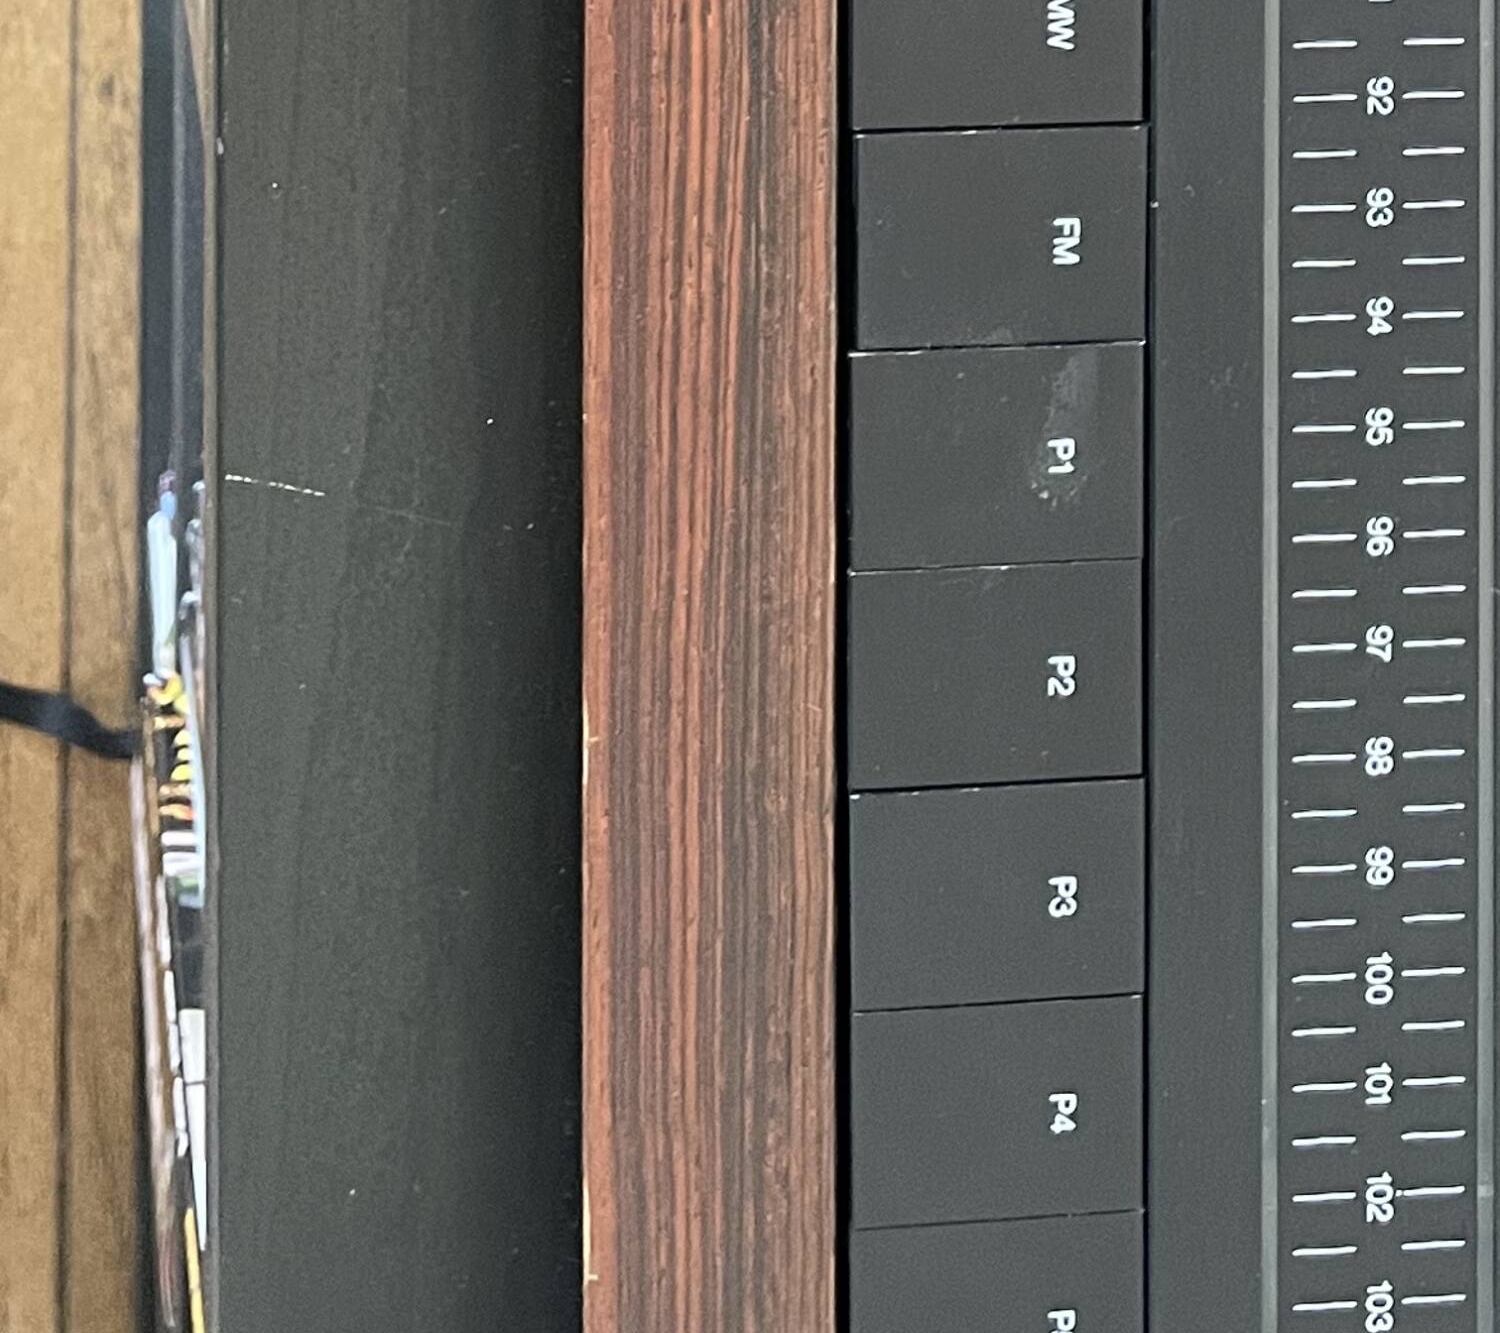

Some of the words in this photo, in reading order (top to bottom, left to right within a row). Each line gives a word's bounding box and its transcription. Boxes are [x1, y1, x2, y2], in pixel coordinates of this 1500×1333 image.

[1366, 76, 1395, 116] 92
[1365, 187, 1394, 228] 93
[1052, 217, 1081, 265] FM
[1365, 296, 1394, 336] 94
[1365, 407, 1394, 447] 95
[1047, 437, 1075, 474] P1
[1366, 516, 1394, 557] 96
[1365, 624, 1394, 663] 97
[1047, 655, 1076, 697] P2
[1364, 736, 1394, 777] 98
[1365, 845, 1394, 886] 99
[1048, 875, 1077, 918] P3
[1364, 951, 1394, 1005] 100
[1364, 1062, 1394, 1105] 101
[1048, 1093, 1078, 1135] P4
[1365, 1171, 1394, 1223] 102
[1047, 1309, 1076, 1333] P
[1364, 1280, 1394, 1333] 103
